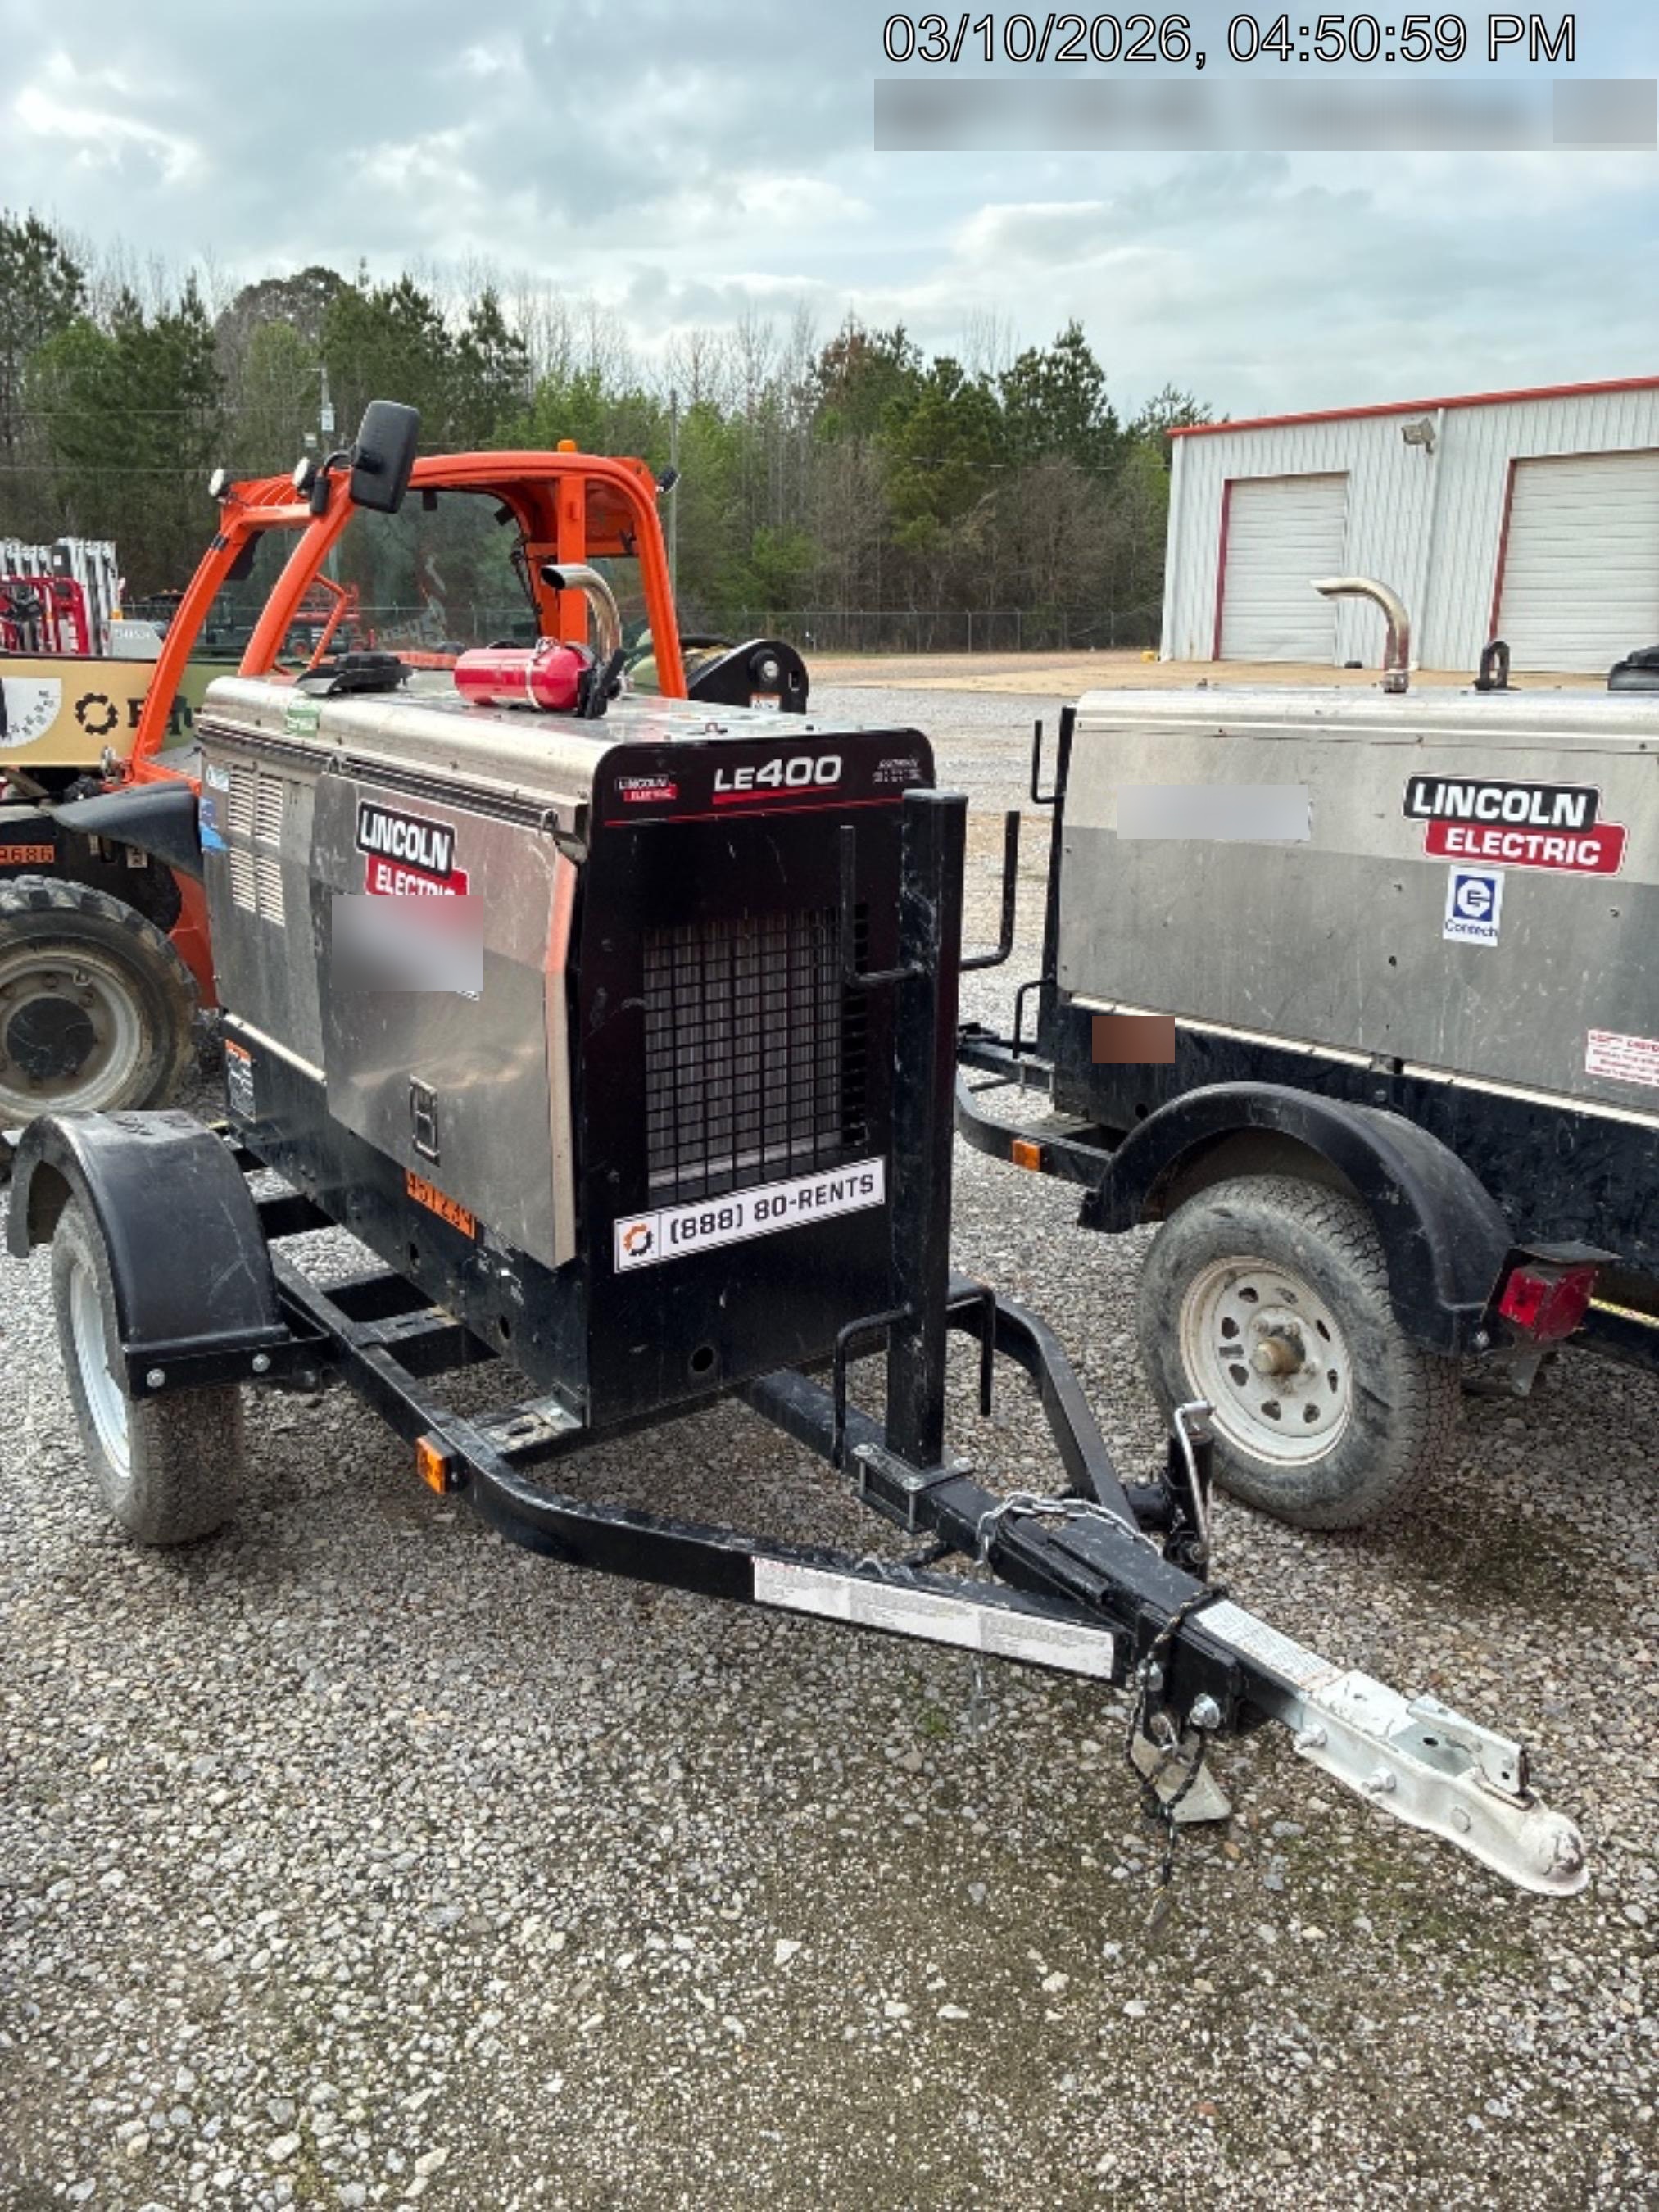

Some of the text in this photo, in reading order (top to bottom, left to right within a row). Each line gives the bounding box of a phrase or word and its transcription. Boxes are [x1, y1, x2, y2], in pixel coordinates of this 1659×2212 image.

[714, 755, 842, 791] LE400
[1413, 783, 1588, 827] LINCOLN
[360, 810, 451, 872] LINCOLN
[1444, 827, 1602, 866] ELECTRIC
[669, 1173, 874, 1244] (888) 80-RENTS
